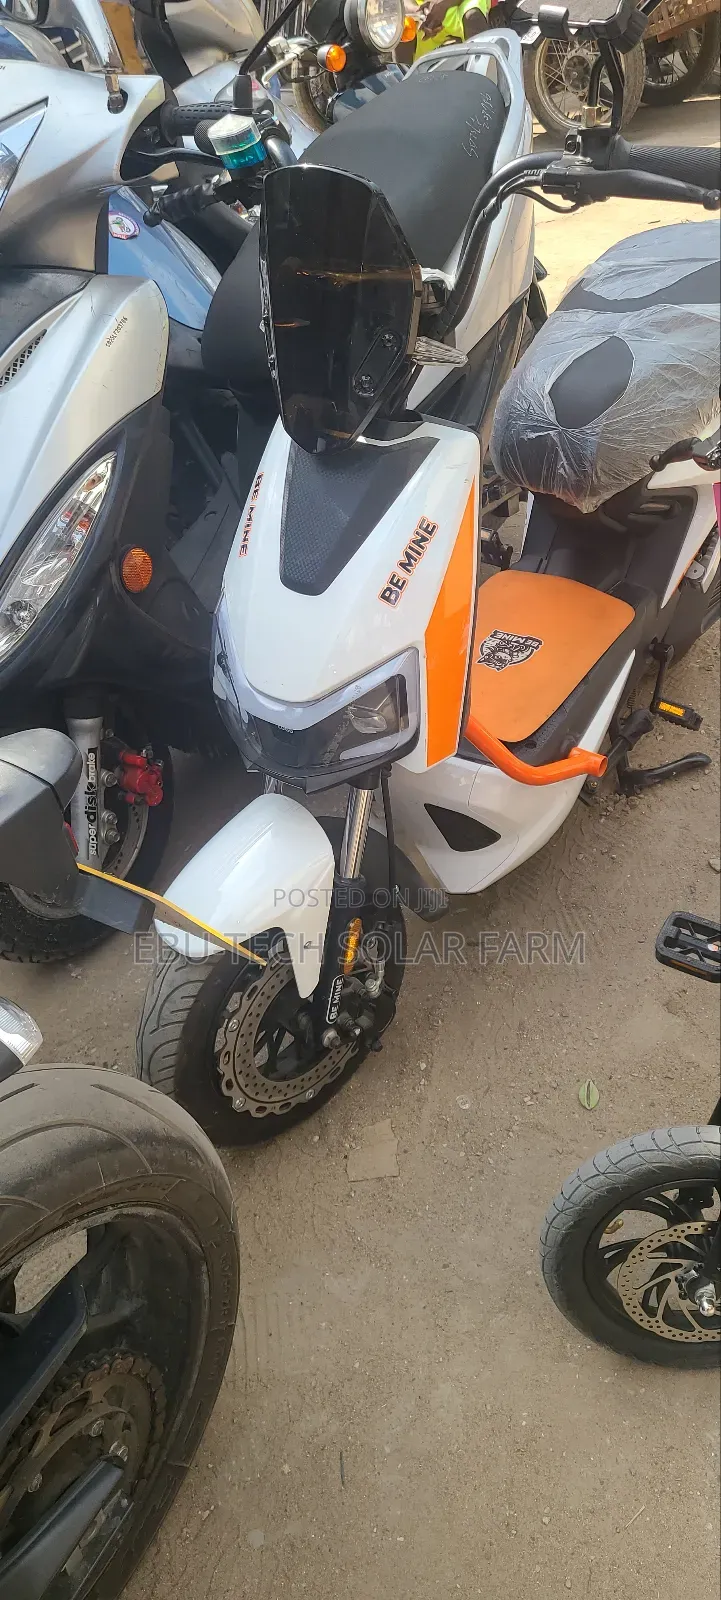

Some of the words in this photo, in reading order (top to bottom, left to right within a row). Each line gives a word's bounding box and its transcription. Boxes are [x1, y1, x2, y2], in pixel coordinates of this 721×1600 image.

[251, 472, 264, 502] BE
[239, 504, 256, 557] MINE
[378, 571, 408, 607] BE
[397, 516, 438, 576] MINE
[494, 632, 526, 643] MINE
[525, 639, 540, 648] BE
[333, 977, 345, 1004] MINE
[329, 1005, 340, 1021] BE
